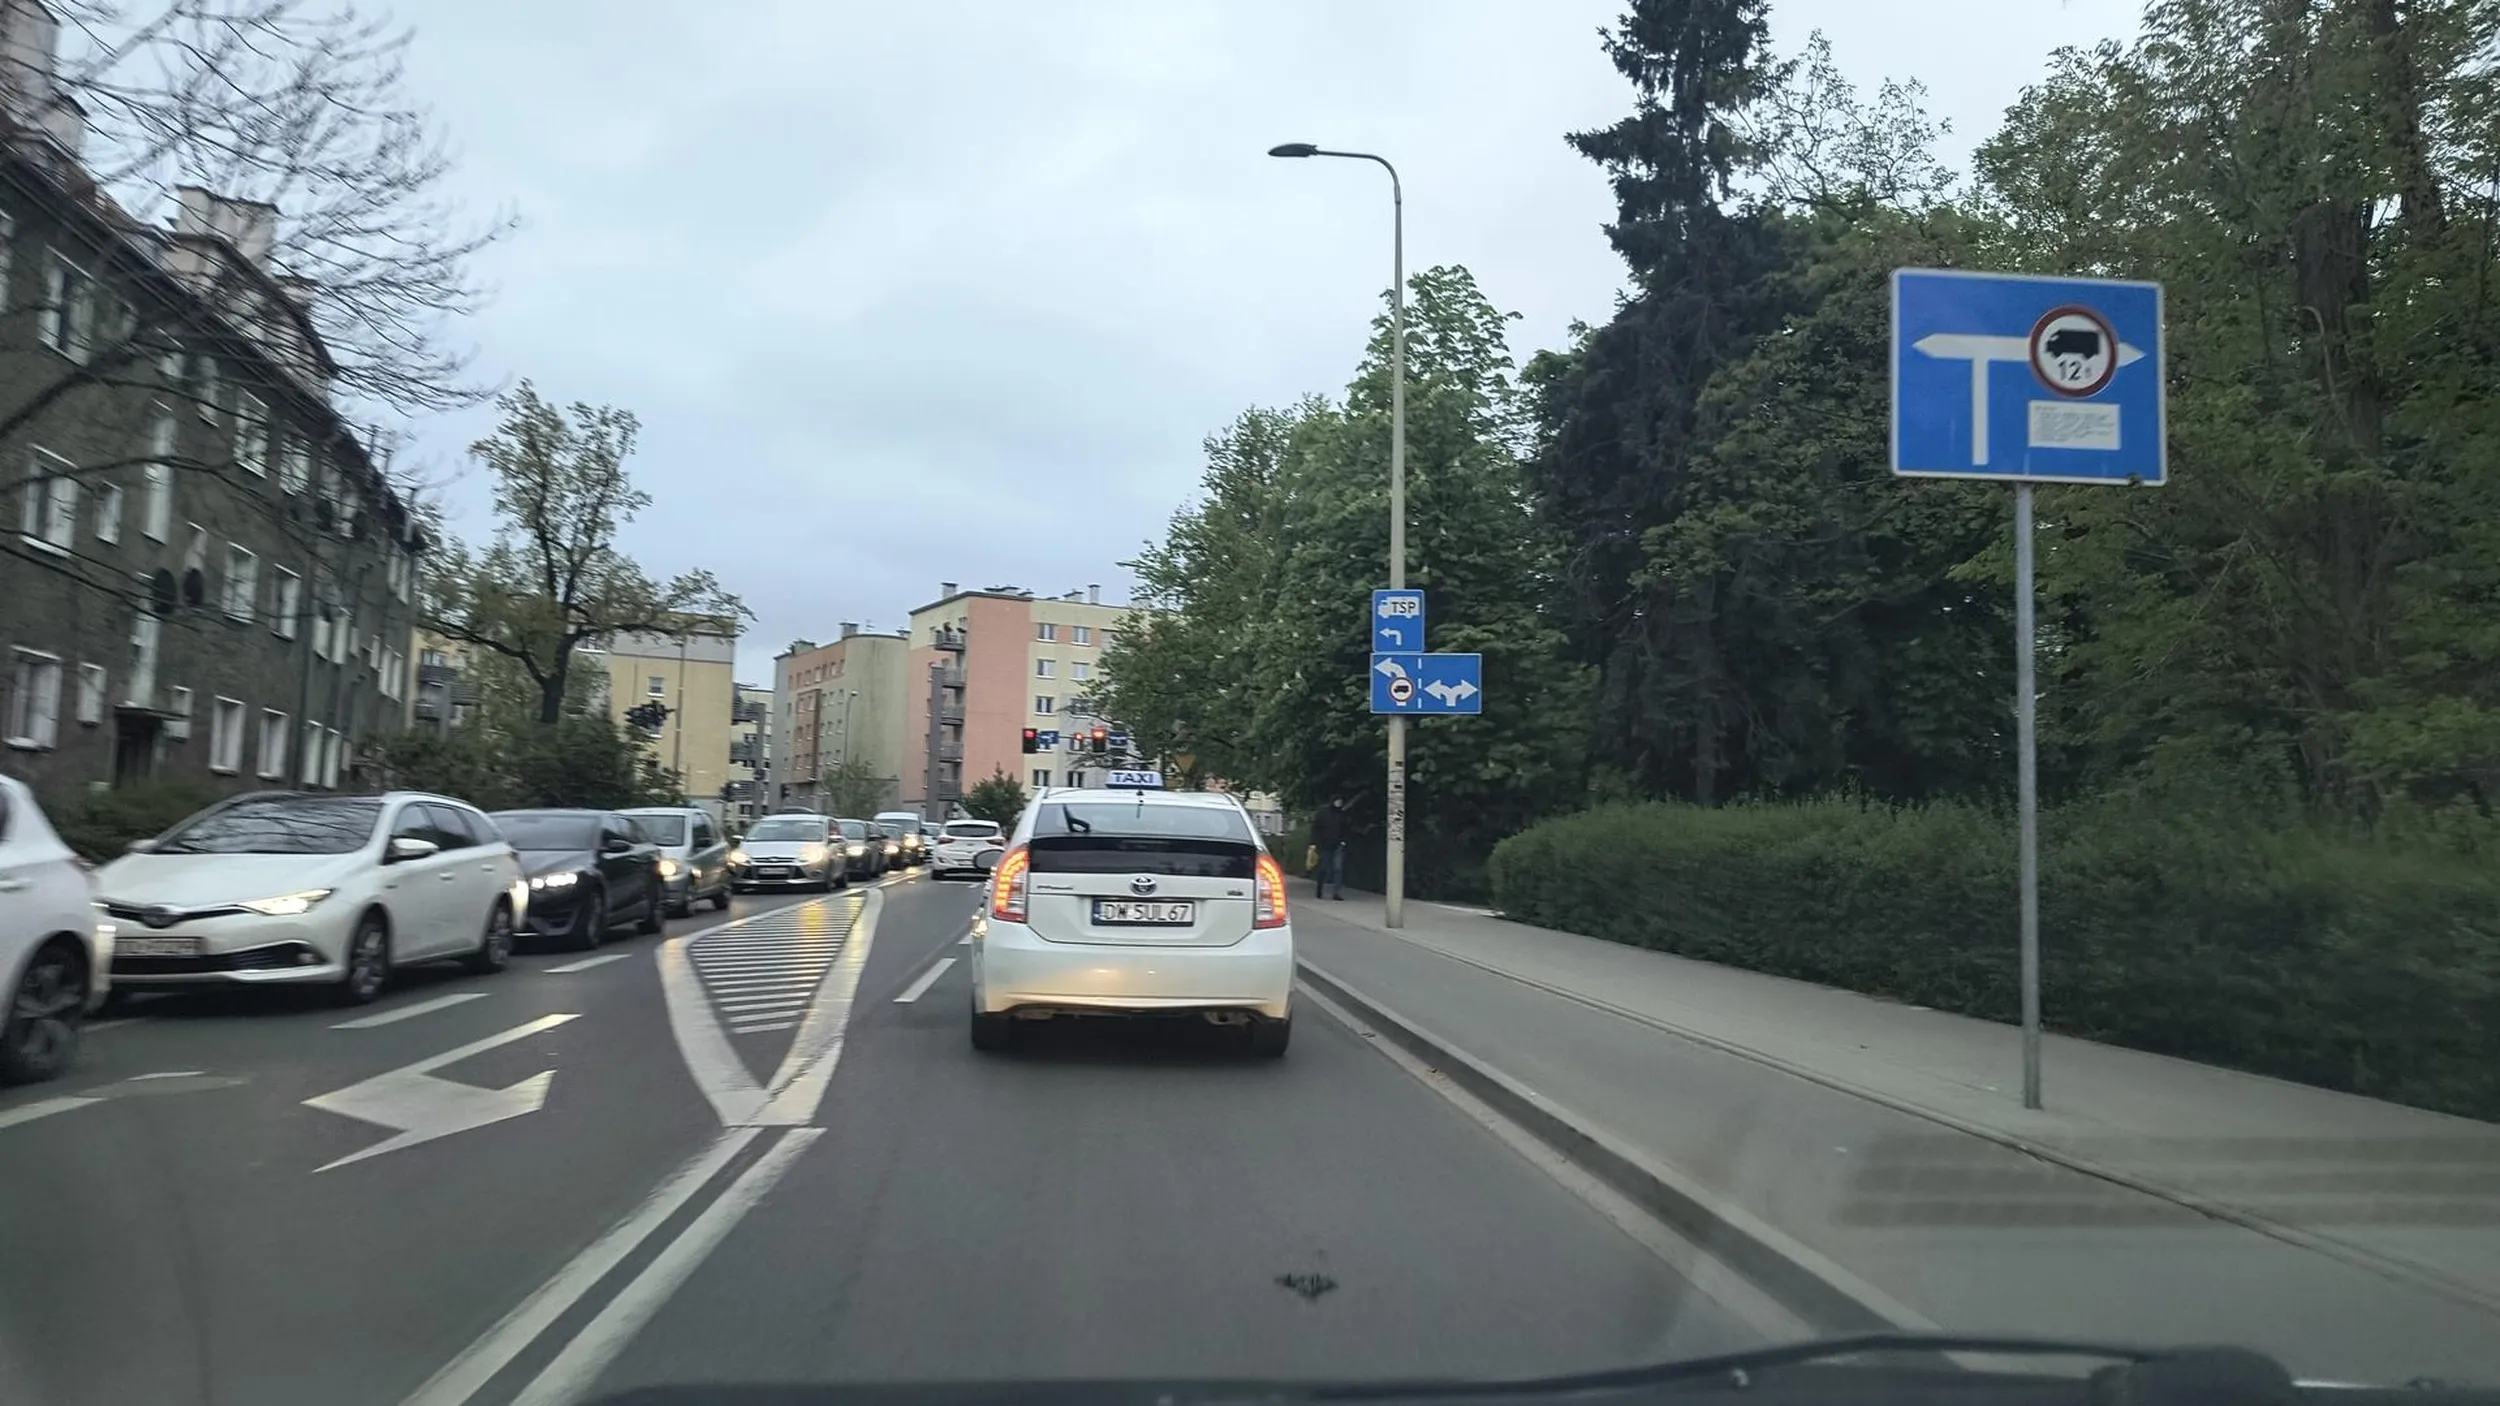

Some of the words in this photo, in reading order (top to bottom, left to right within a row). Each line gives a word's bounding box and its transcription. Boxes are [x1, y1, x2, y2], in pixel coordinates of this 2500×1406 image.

[1391, 601, 1416, 614] TSP
[1112, 772, 1153, 783] TAXI
[1104, 904, 1128, 919] DW
